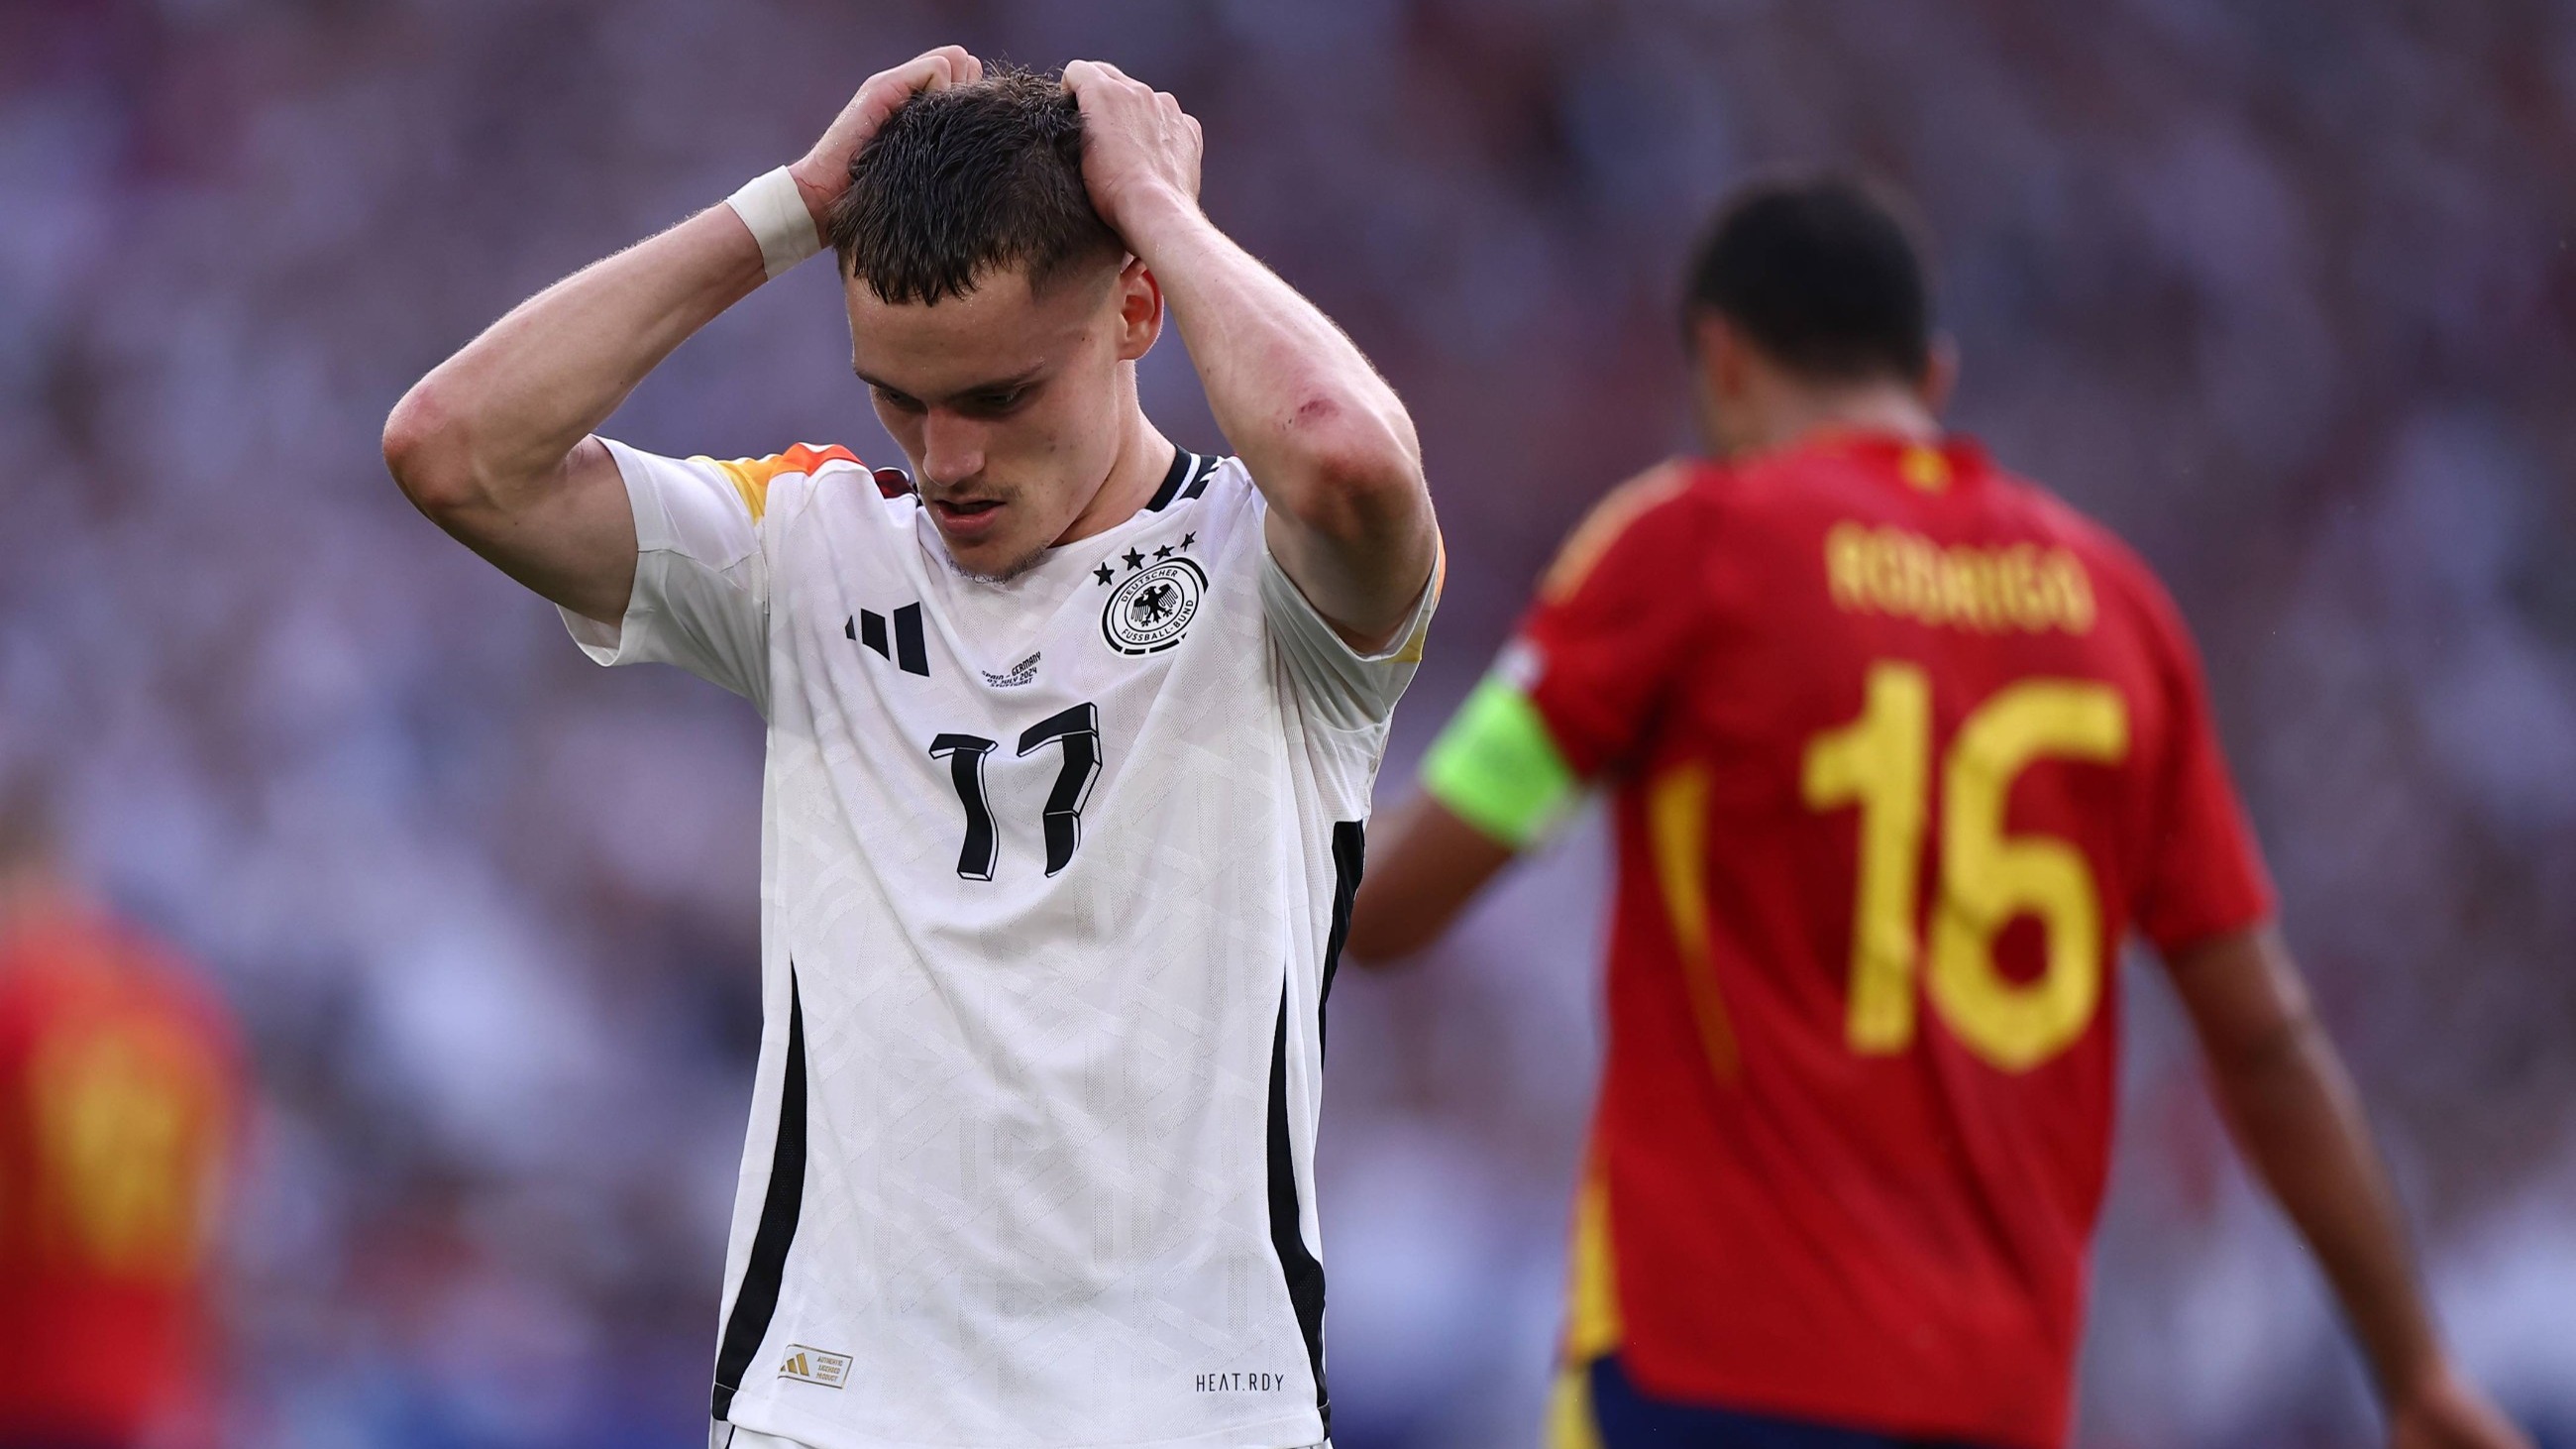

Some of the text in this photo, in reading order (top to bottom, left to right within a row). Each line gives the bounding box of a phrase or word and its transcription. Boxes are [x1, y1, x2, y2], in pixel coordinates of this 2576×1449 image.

[1121, 569, 1178, 603] DEUTSCHER
[1825, 520, 2096, 634] RODRIGO
[1122, 600, 1194, 641] FUSSBALL-BUND
[1012, 650, 1041, 676] GERMANY
[1020, 666, 1037, 681] 2024
[928, 702, 1103, 882] 17
[1801, 658, 2128, 1074] 16
[1196, 1373, 1284, 1393] HEAT.RDY
